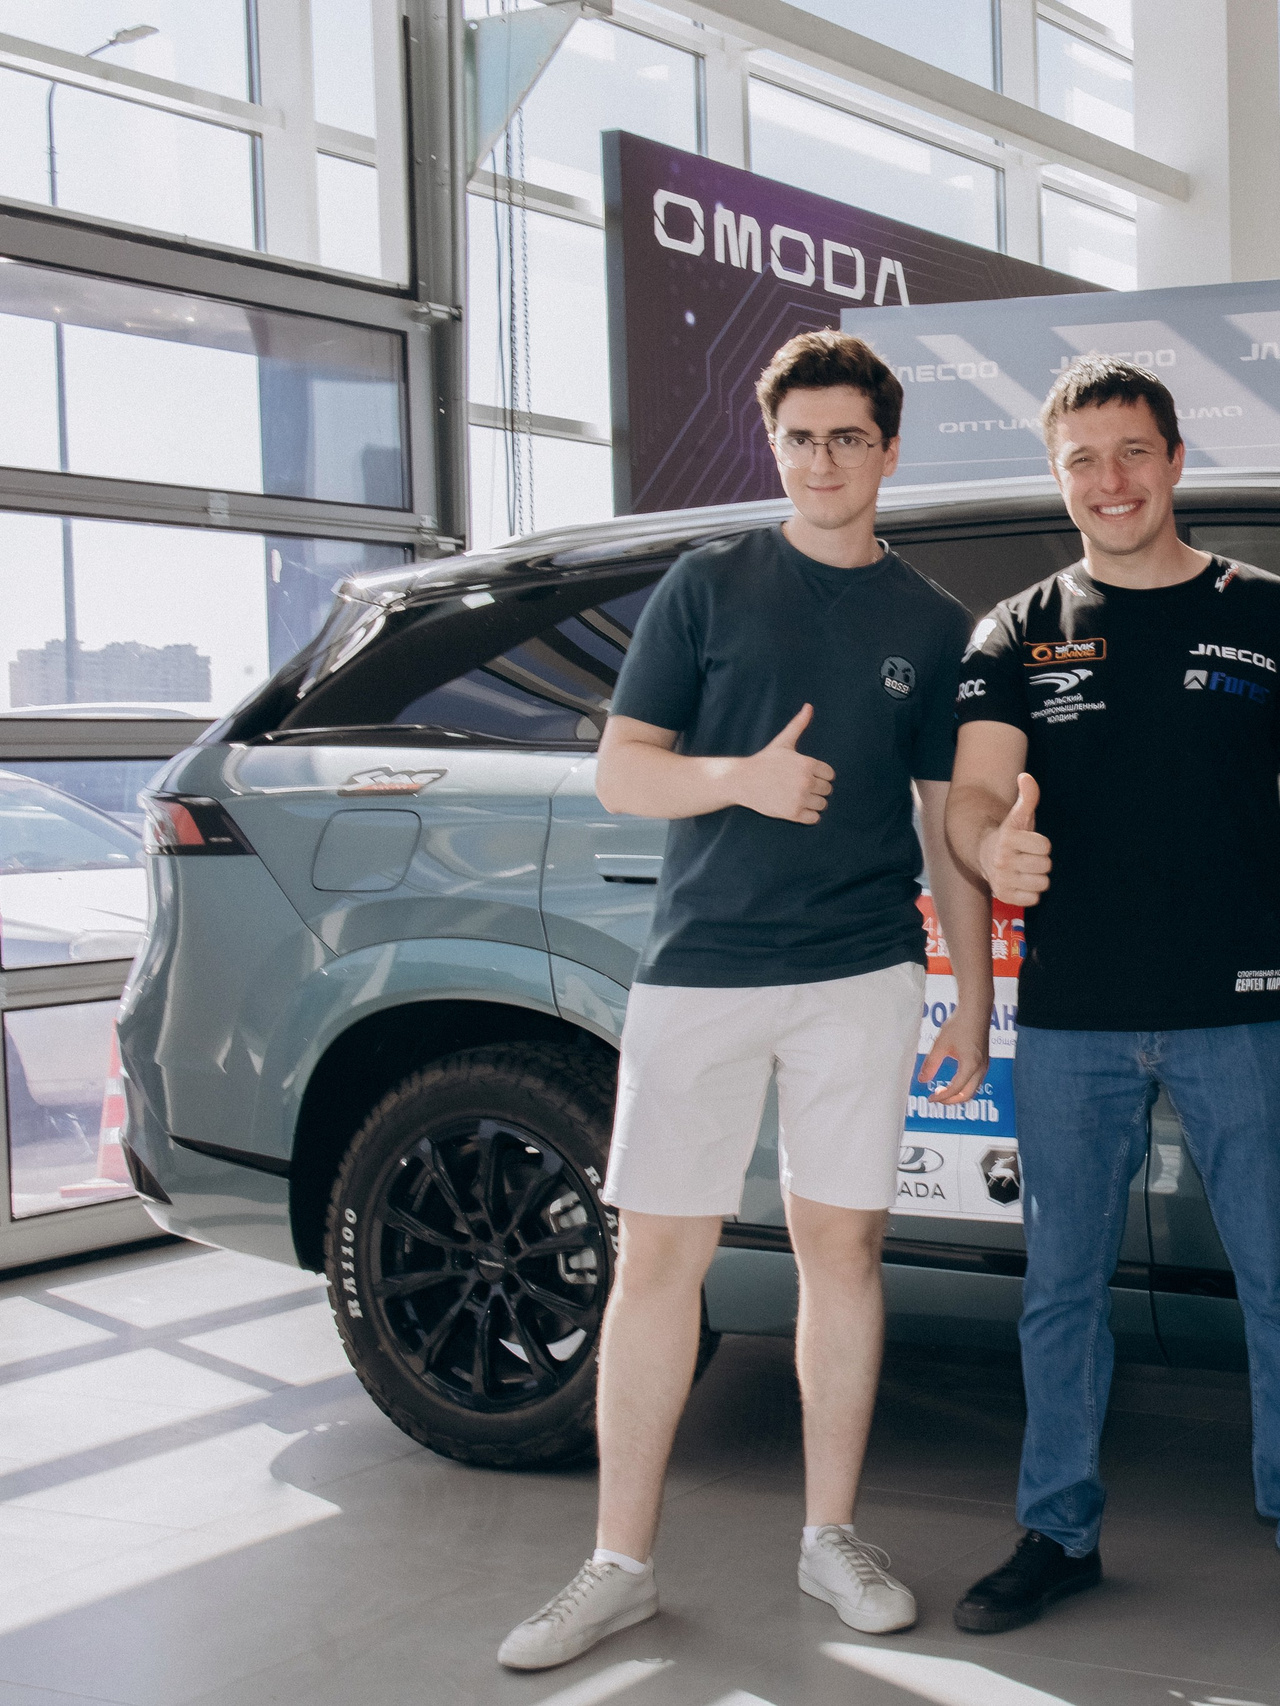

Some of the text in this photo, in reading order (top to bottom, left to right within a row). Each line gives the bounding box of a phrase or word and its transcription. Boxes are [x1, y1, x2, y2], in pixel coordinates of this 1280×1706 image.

[653, 188, 910, 307] OMODA
[893, 361, 999, 383] AECOO
[1189, 643, 1277, 673] JAECOO
[897, 1181, 946, 1200] ADA
